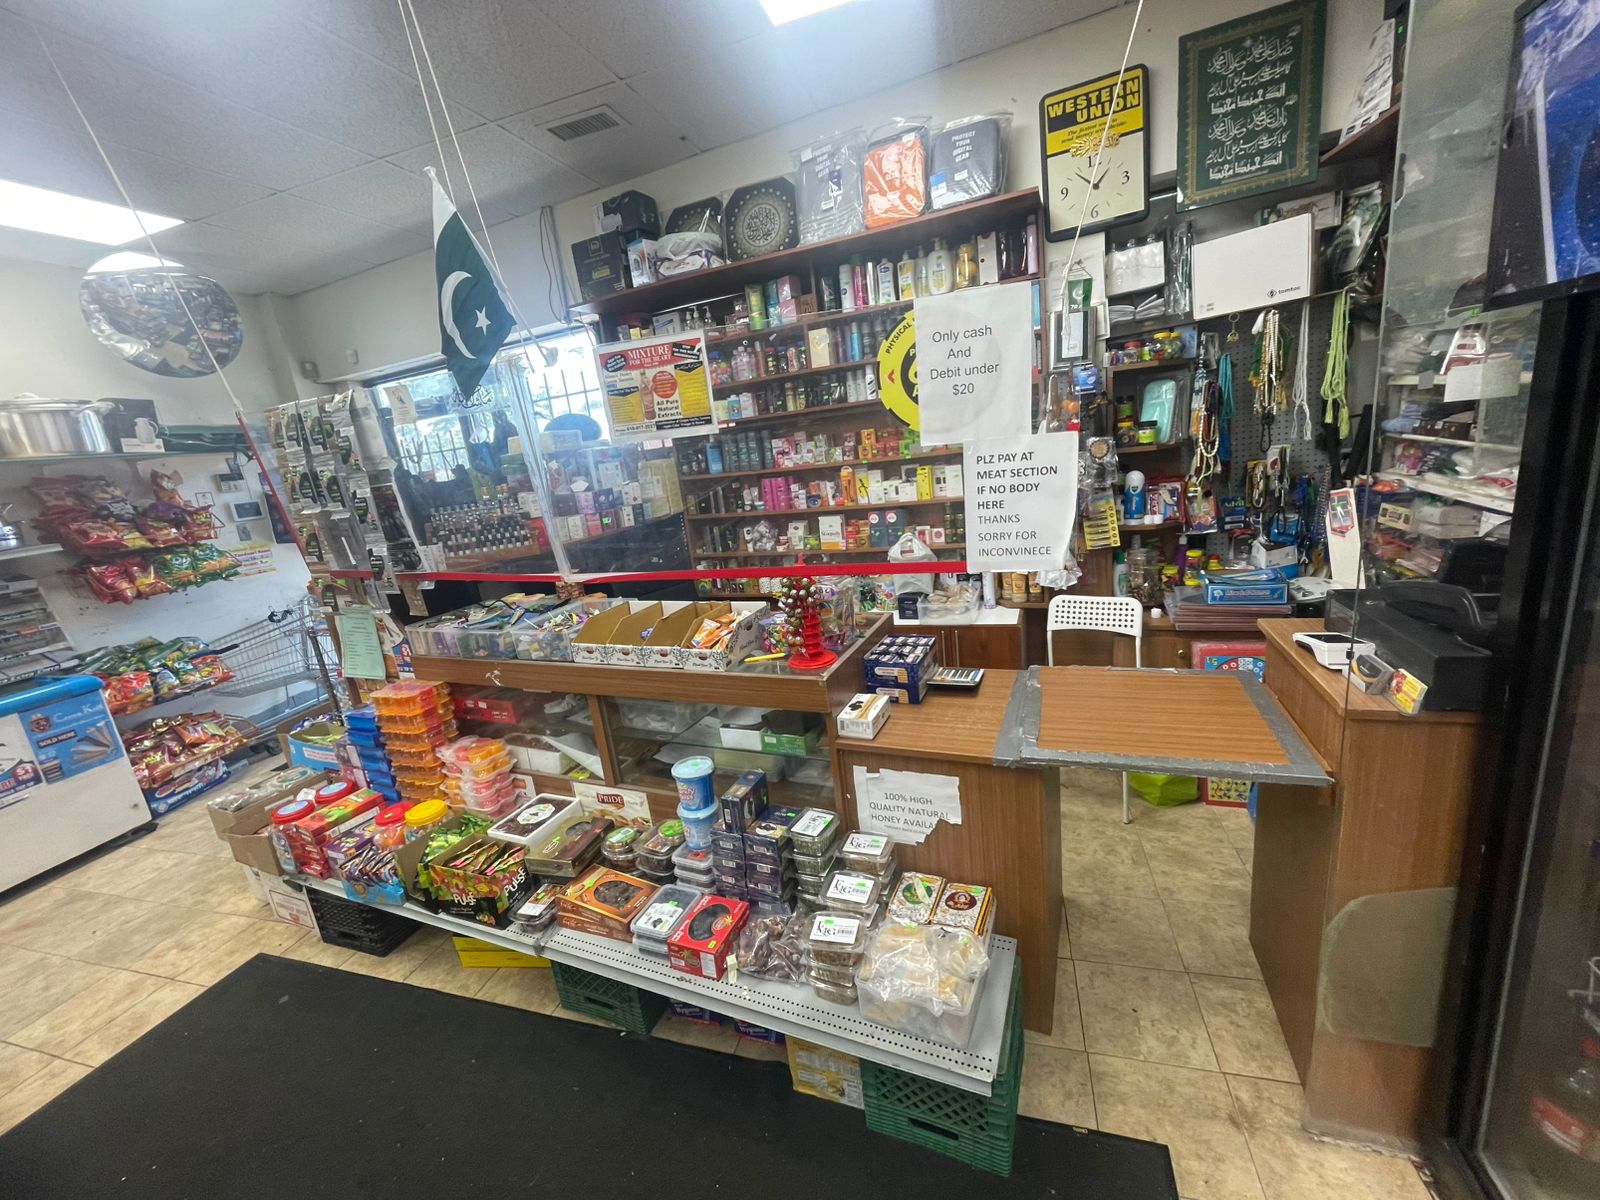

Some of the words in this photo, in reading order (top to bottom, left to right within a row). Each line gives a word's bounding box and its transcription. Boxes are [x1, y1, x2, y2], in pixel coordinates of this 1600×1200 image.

[1047, 78, 1140, 117] WESTERN
[1076, 92, 1140, 123] UNION
[951, 130, 976, 142] PROTECT
[1121, 170, 1130, 185] 3
[1060, 187, 1069, 200] 9
[1090, 204, 1099, 219] 6
[885, 322, 912, 355] PHYSICAL
[932, 330, 960, 343] Only
[963, 325, 993, 339] cash
[627, 344, 670, 360] MIXTURE
[947, 346, 972, 360] And
[930, 366, 961, 380] Debit
[964, 362, 1000, 377] under
[952, 383, 975, 396] $20
[976, 454, 995, 465] PLZ
[997, 452, 1018, 463] PAY
[1020, 451, 1035, 462] AT
[976, 469, 1007, 480] MEAT
[1010, 465, 1058, 477] SECTION
[977, 486, 987, 495] IF
[989, 484, 1006, 494] NO
[1009, 482, 1041, 493] BODY
[977, 500, 1005, 510] HERE
[977, 513, 1021, 525] THANKS
[978, 531, 1013, 542] SORRY
[1015, 530, 1037, 540] FOR
[978, 546, 1052, 557] INCONVINECE
[38, 737, 57, 748] SOLD
[58, 731, 76, 743] HERE
[598, 793, 624, 804] PRIDE
[884, 792, 908, 802] 100%
[909, 795, 933, 805] HIGH
[869, 801, 906, 813] QUALITY
[908, 807, 951, 820] NATURAL
[871, 813, 901, 824] HONEY
[503, 867, 527, 897] PULSE
[453, 892, 477, 906] PULSE
